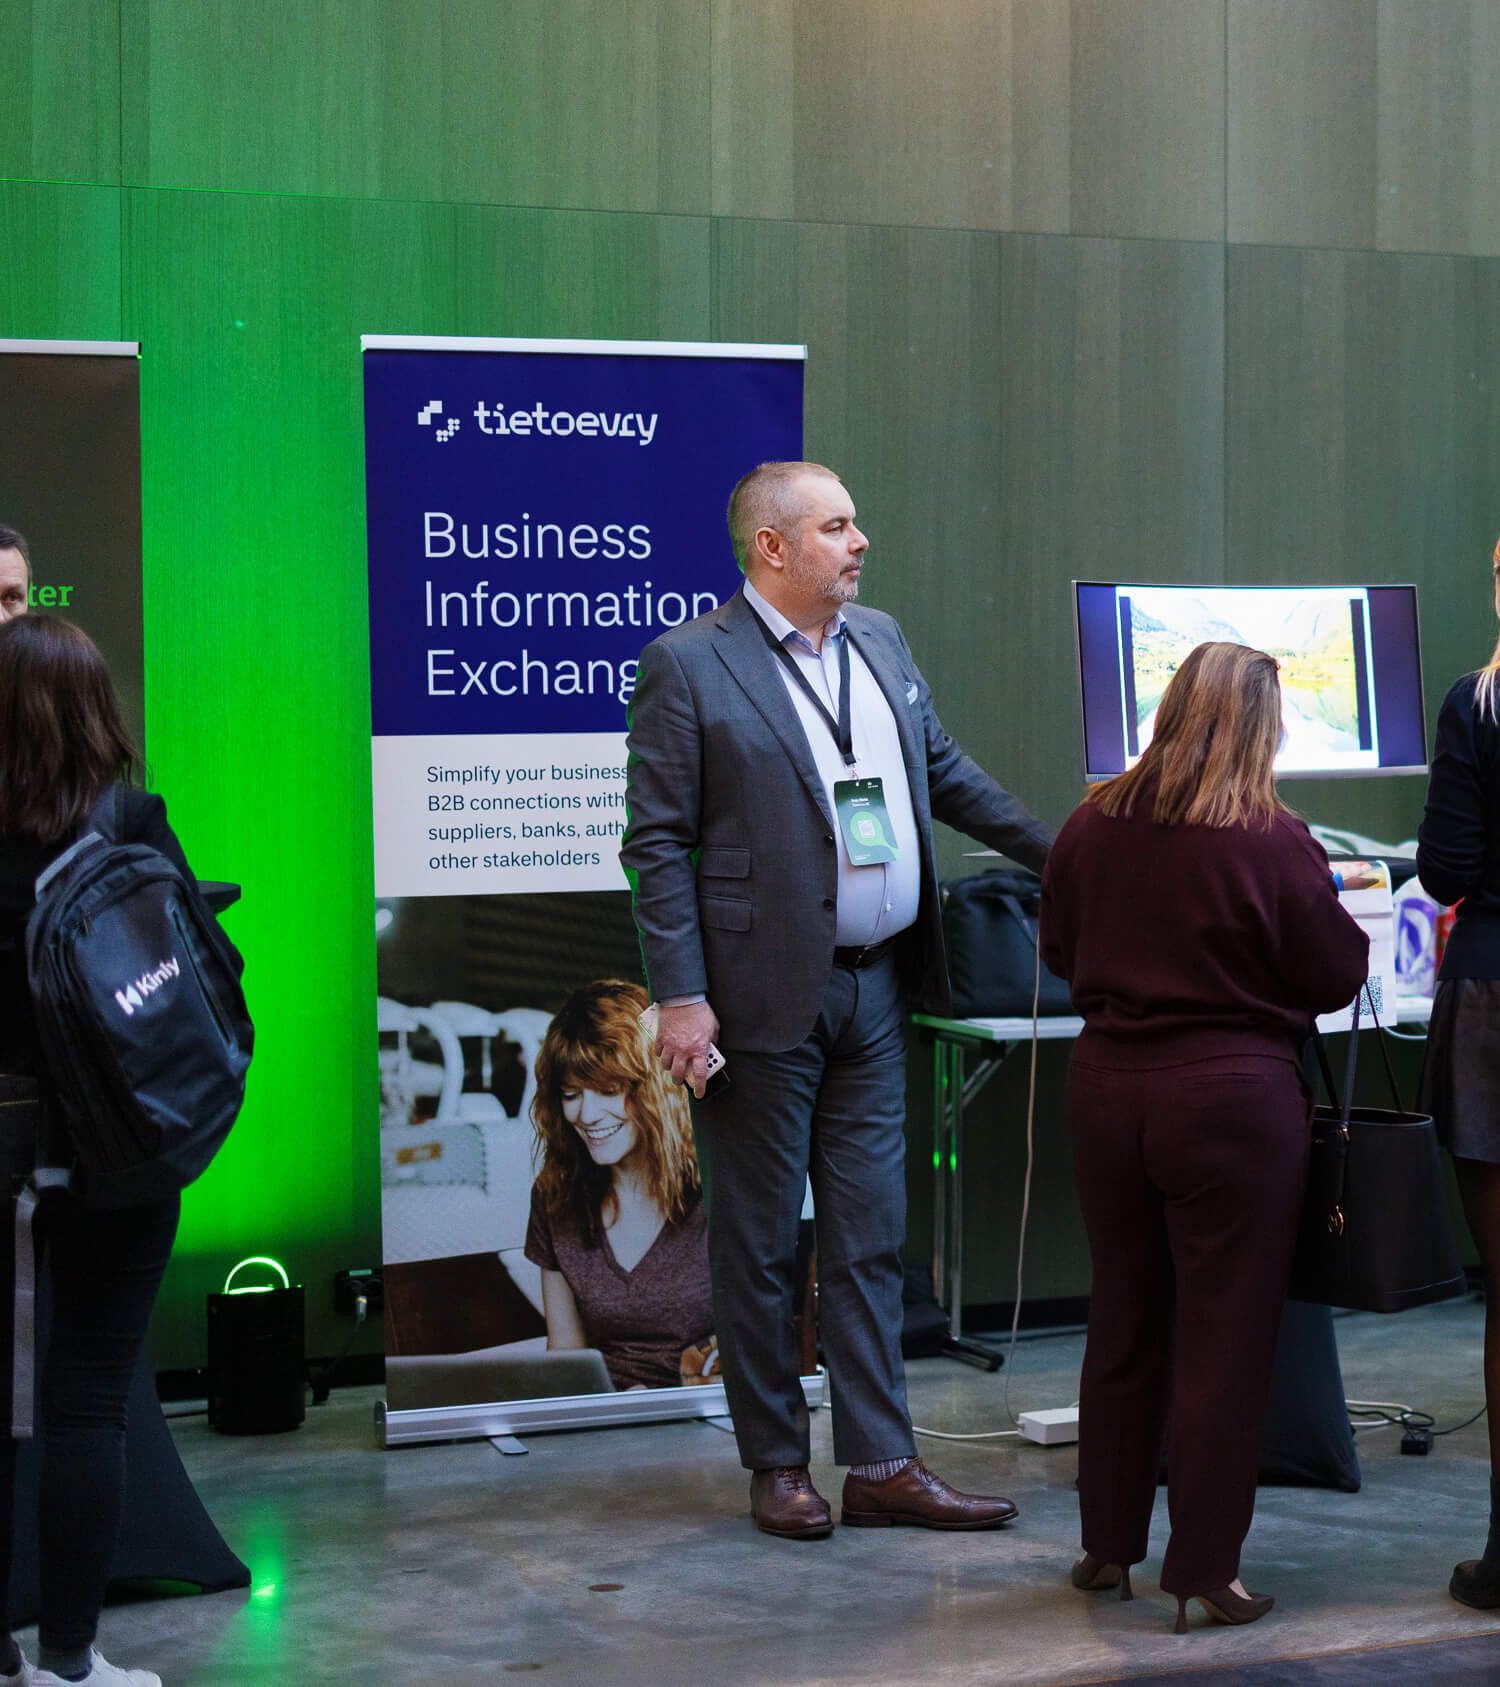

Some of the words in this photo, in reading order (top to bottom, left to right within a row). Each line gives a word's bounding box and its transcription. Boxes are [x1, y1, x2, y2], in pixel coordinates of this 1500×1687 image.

[473, 400, 659, 446] tietoevry
[424, 511, 652, 560] Business
[28, 581, 75, 607] ter
[425, 580, 720, 627] Information
[427, 648, 640, 704] Exchang
[426, 765, 501, 786] Simplify
[505, 767, 547, 785] your
[551, 764, 628, 781] business
[428, 794, 465, 812] B2B
[470, 793, 582, 811] connections
[586, 791, 624, 808] with
[428, 823, 517, 843] suppliers,
[521, 821, 581, 839] banks,
[585, 820, 625, 837] auth
[428, 852, 479, 870] other
[483, 849, 601, 868] stakeholders
[135, 956, 180, 996] Kinly
